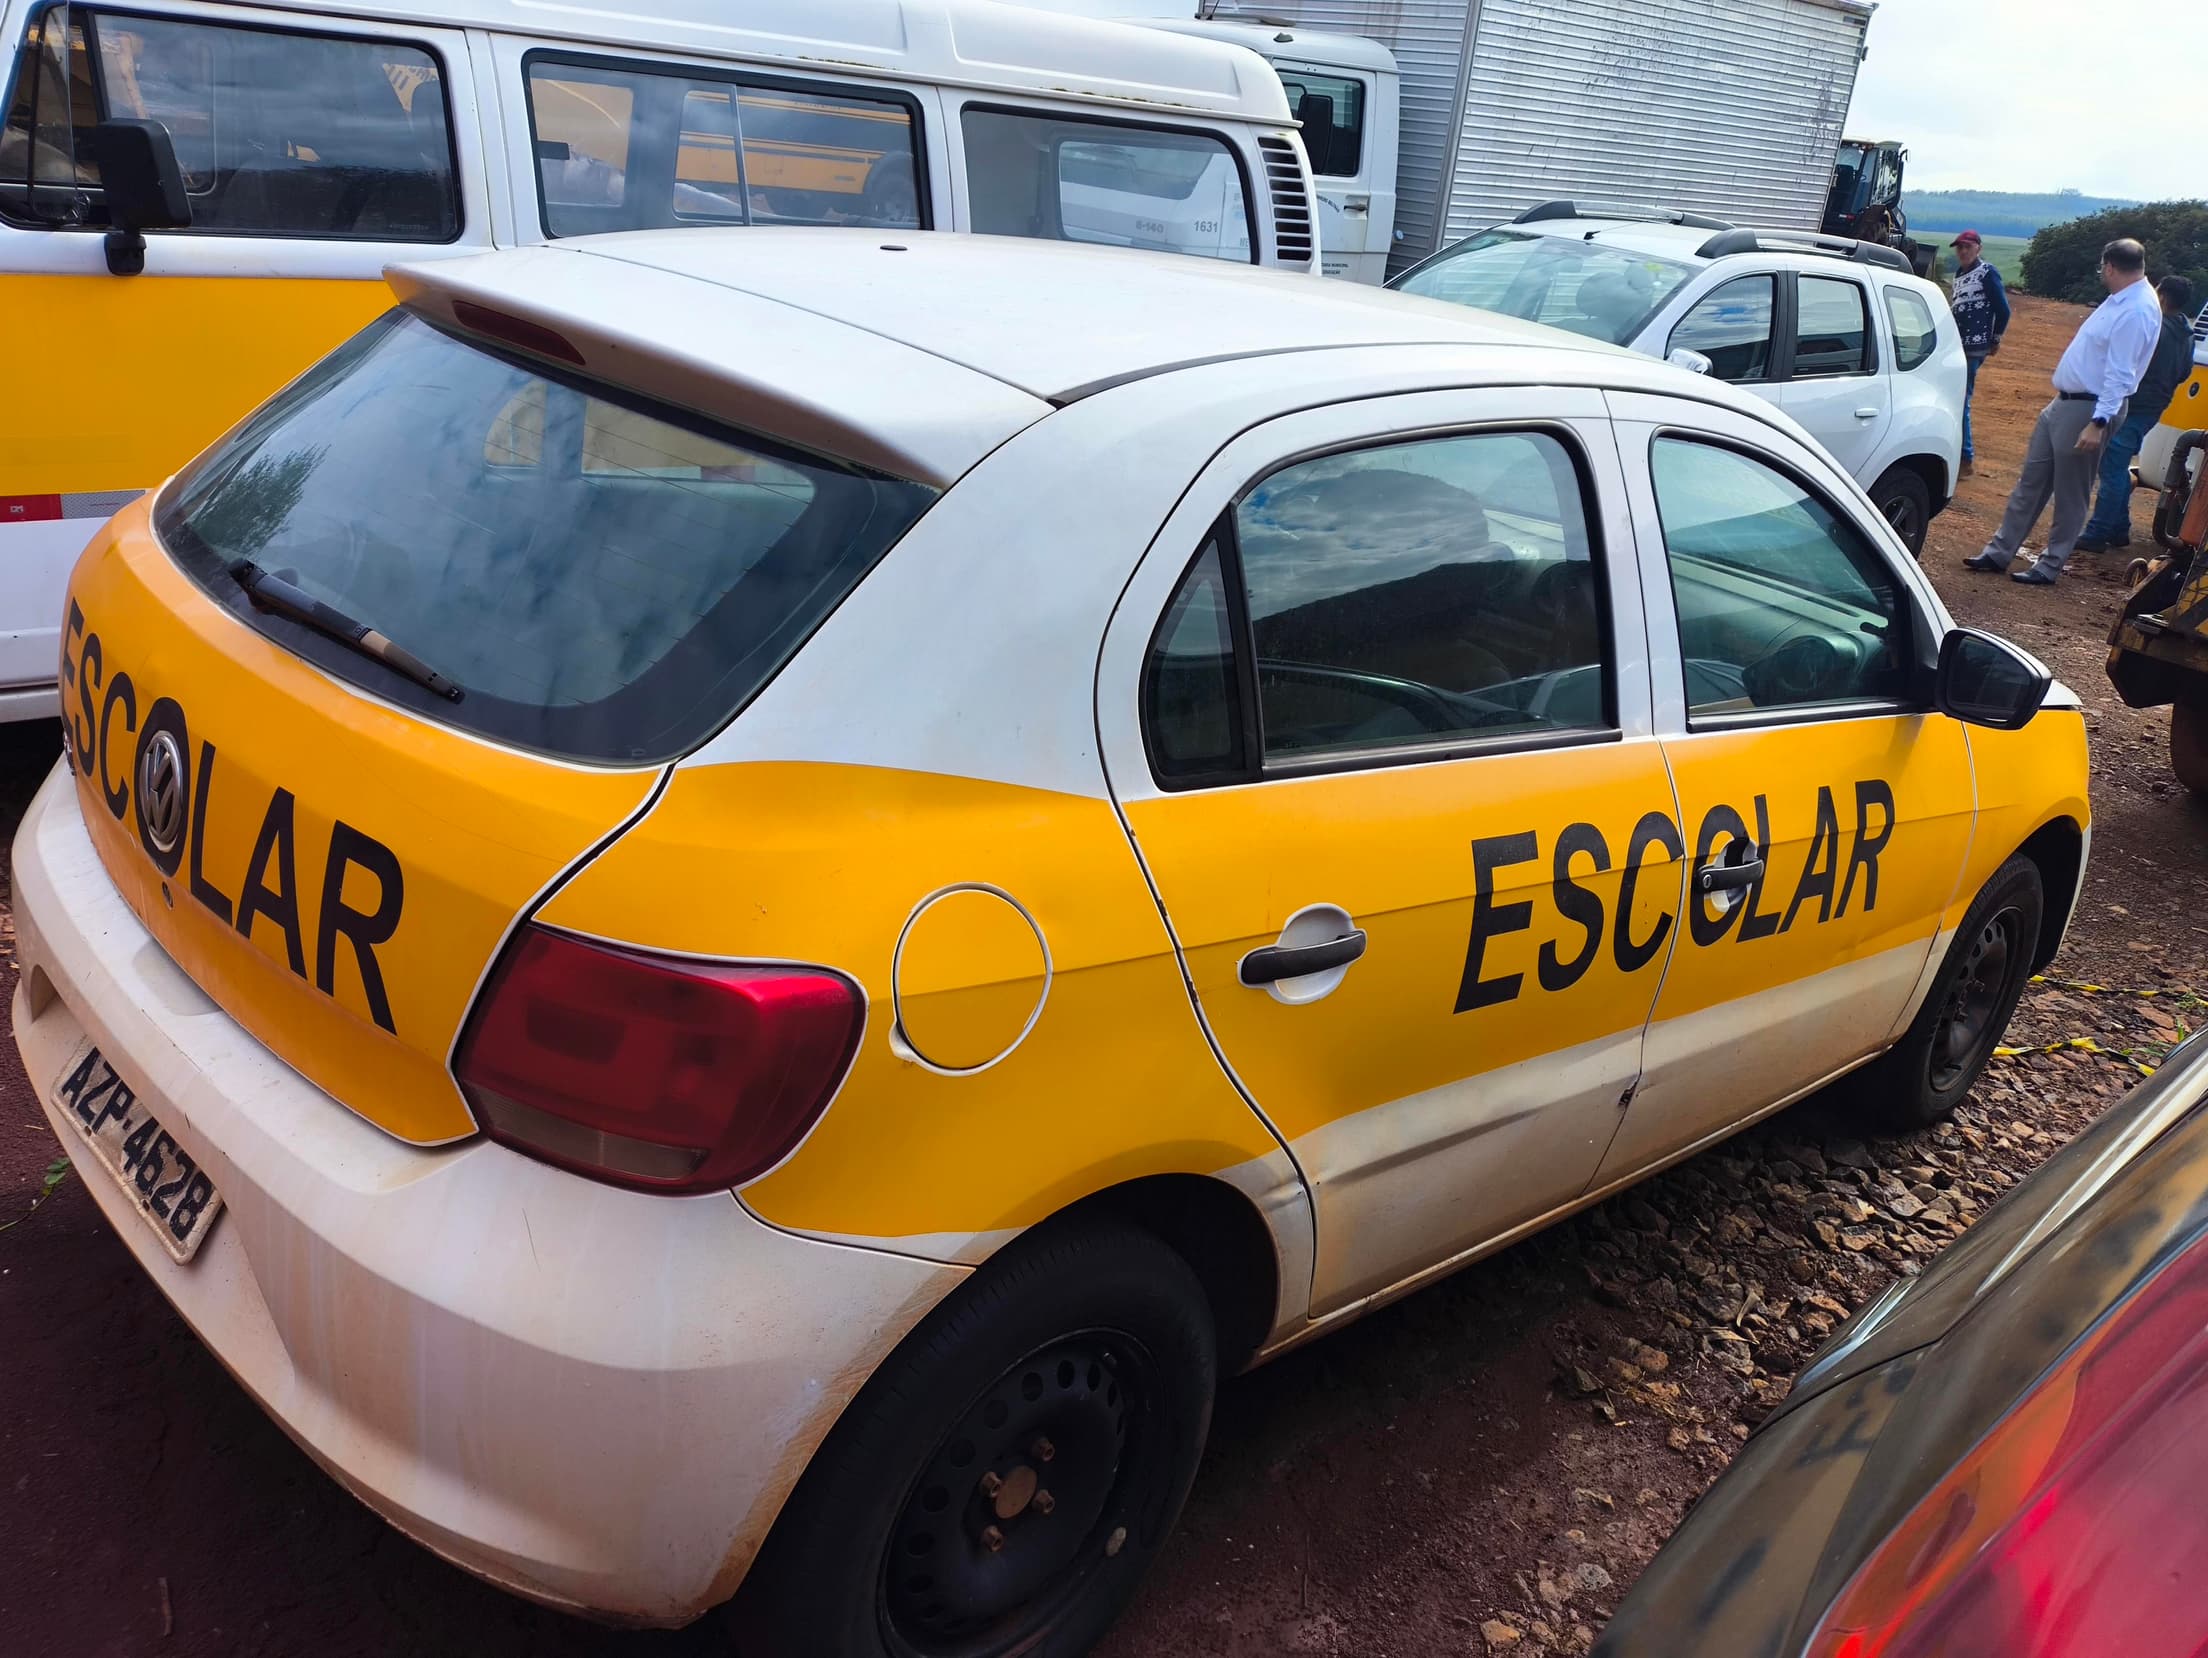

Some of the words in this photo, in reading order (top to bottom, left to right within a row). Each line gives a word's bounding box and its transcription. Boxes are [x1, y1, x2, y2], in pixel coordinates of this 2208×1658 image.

[1194, 220, 1218, 233] 1631
[61, 596, 404, 1036] ESCOLAR
[1453, 779, 1895, 1015] ESCOLAR
